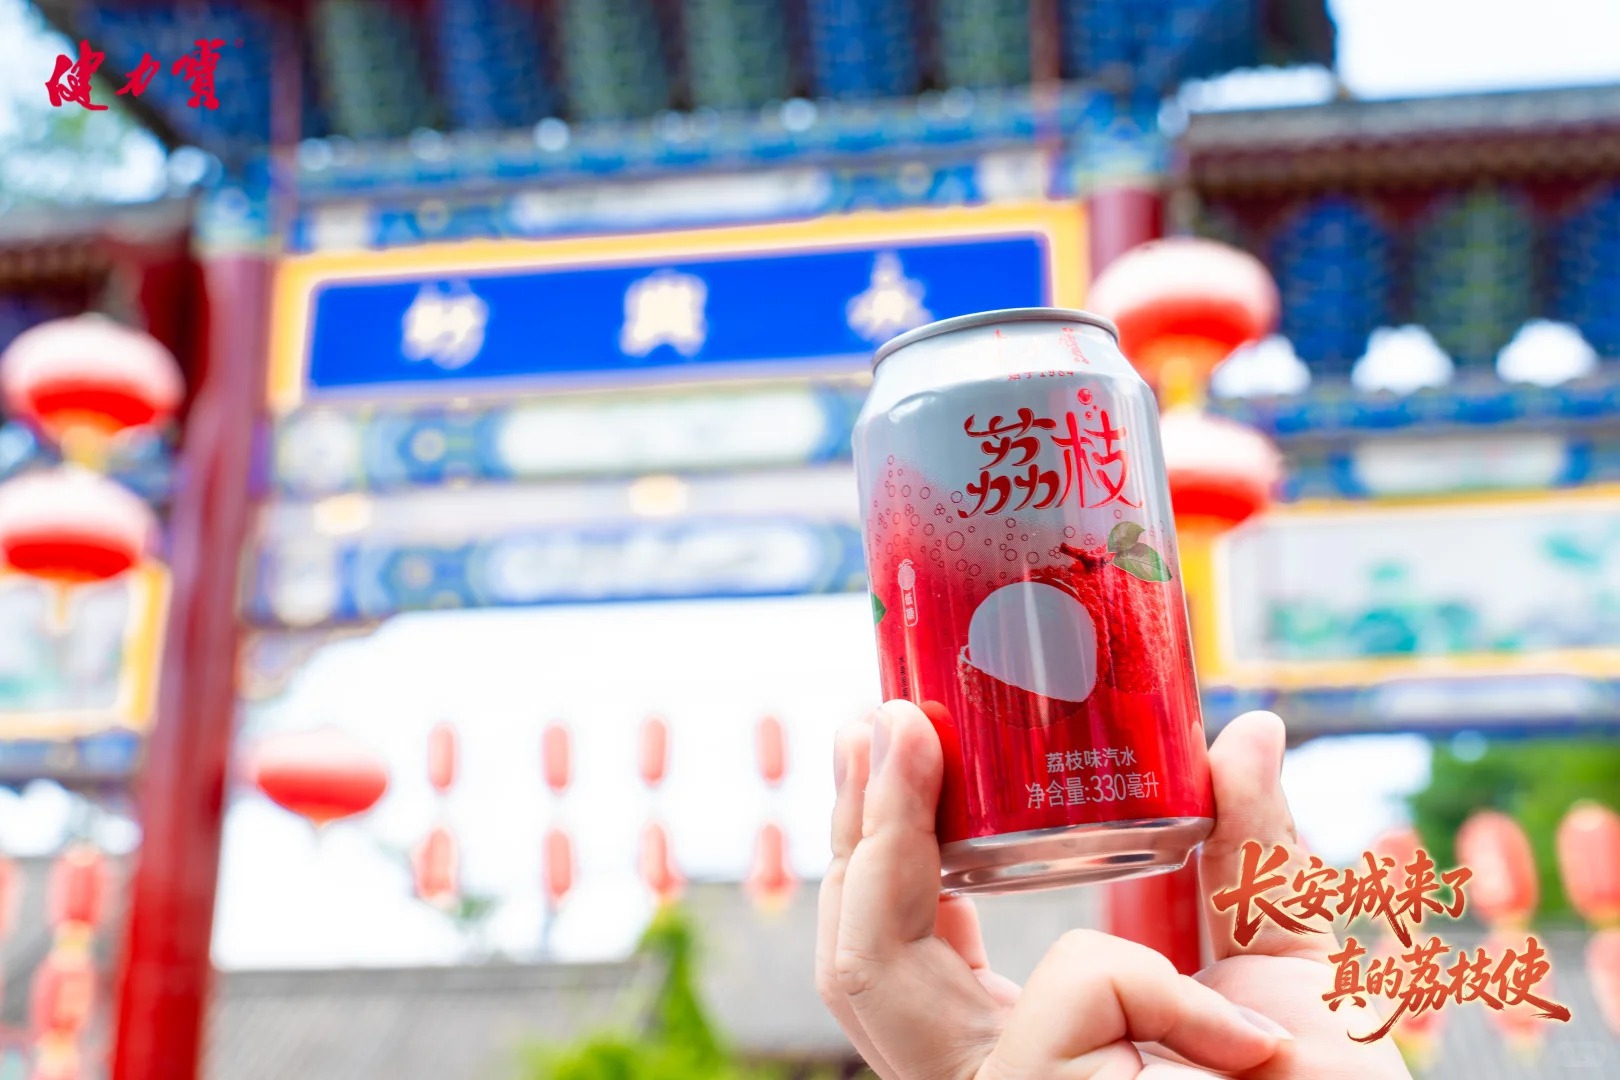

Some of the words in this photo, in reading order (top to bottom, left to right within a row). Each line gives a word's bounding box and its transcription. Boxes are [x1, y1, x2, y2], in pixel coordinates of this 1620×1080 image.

[958, 407, 1143, 519] 荔枝
[1045, 745, 1137, 773] 荔枝味汽水
